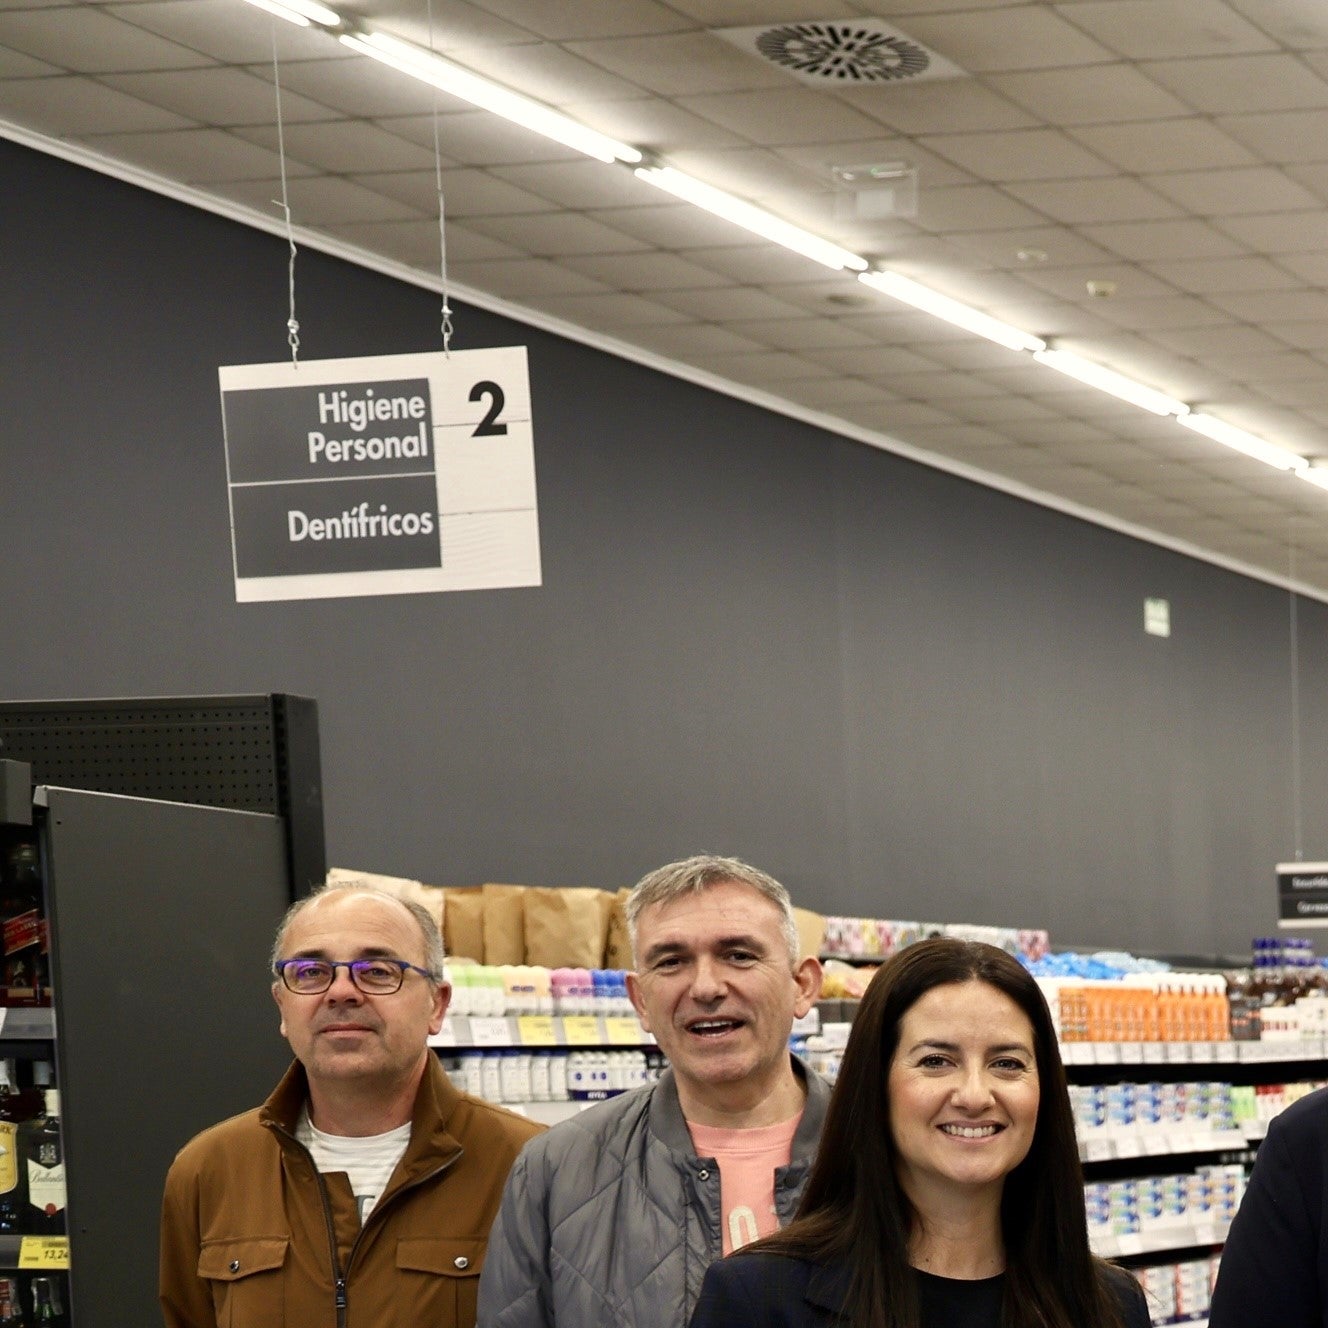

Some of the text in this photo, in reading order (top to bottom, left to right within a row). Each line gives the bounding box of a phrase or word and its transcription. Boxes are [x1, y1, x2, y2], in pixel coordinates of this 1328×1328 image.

[318, 389, 426, 432] Higiene
[468, 380, 507, 438] 2
[308, 421, 429, 463] Personal
[287, 502, 434, 542] Dentífricos
